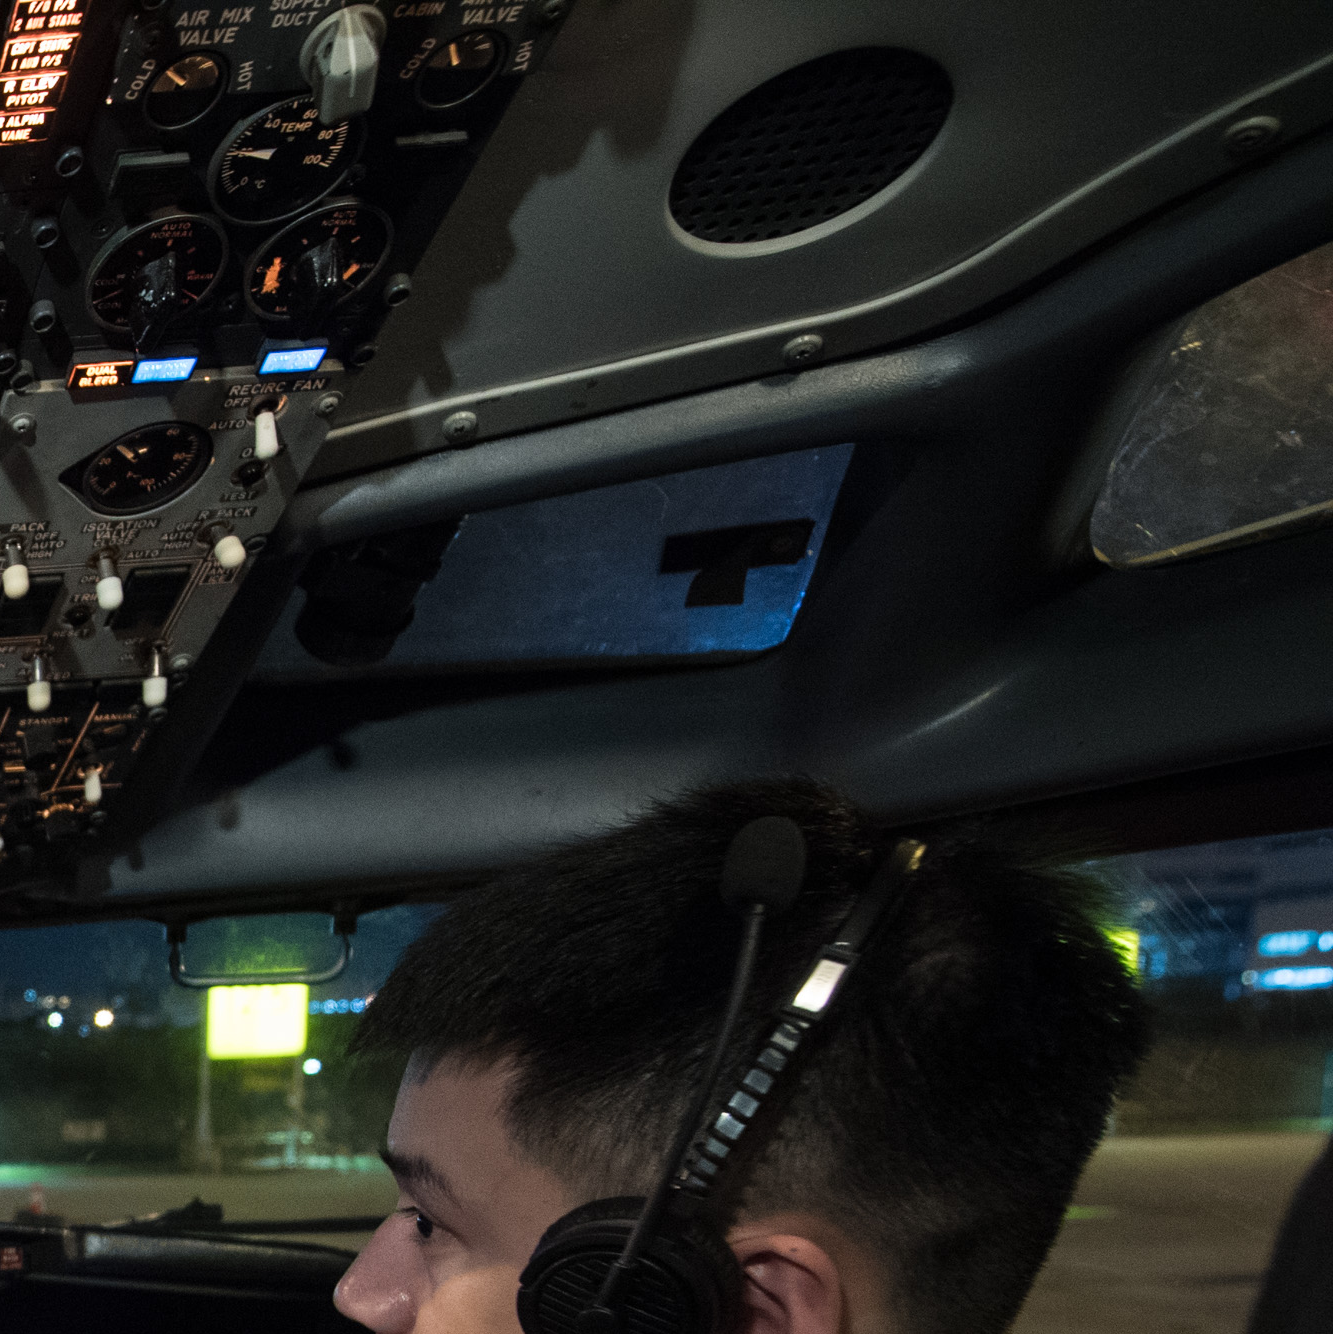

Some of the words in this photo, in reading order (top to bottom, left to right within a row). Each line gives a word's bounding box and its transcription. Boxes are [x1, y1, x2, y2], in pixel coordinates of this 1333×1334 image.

[175, 11, 209, 28] AIR
[220, 9, 253, 24] MIX
[271, 11, 319, 28] DUCT
[462, 5, 521, 26] VALVE
[178, 27, 237, 46] VALVE
[400, 38, 437, 80] COLD
[125, 59, 157, 101] COLD
[6, 92, 45, 106] PITOT
[1, 128, 31, 142] VANE
[280, 121, 313, 134] TEMP
[86, 365, 117, 377] DUAL
[78, 375, 118, 388] BLEED
[228, 382, 286, 396] RECIRC
[292, 378, 325, 392] FAN
[208, 419, 247, 431] AUTO
